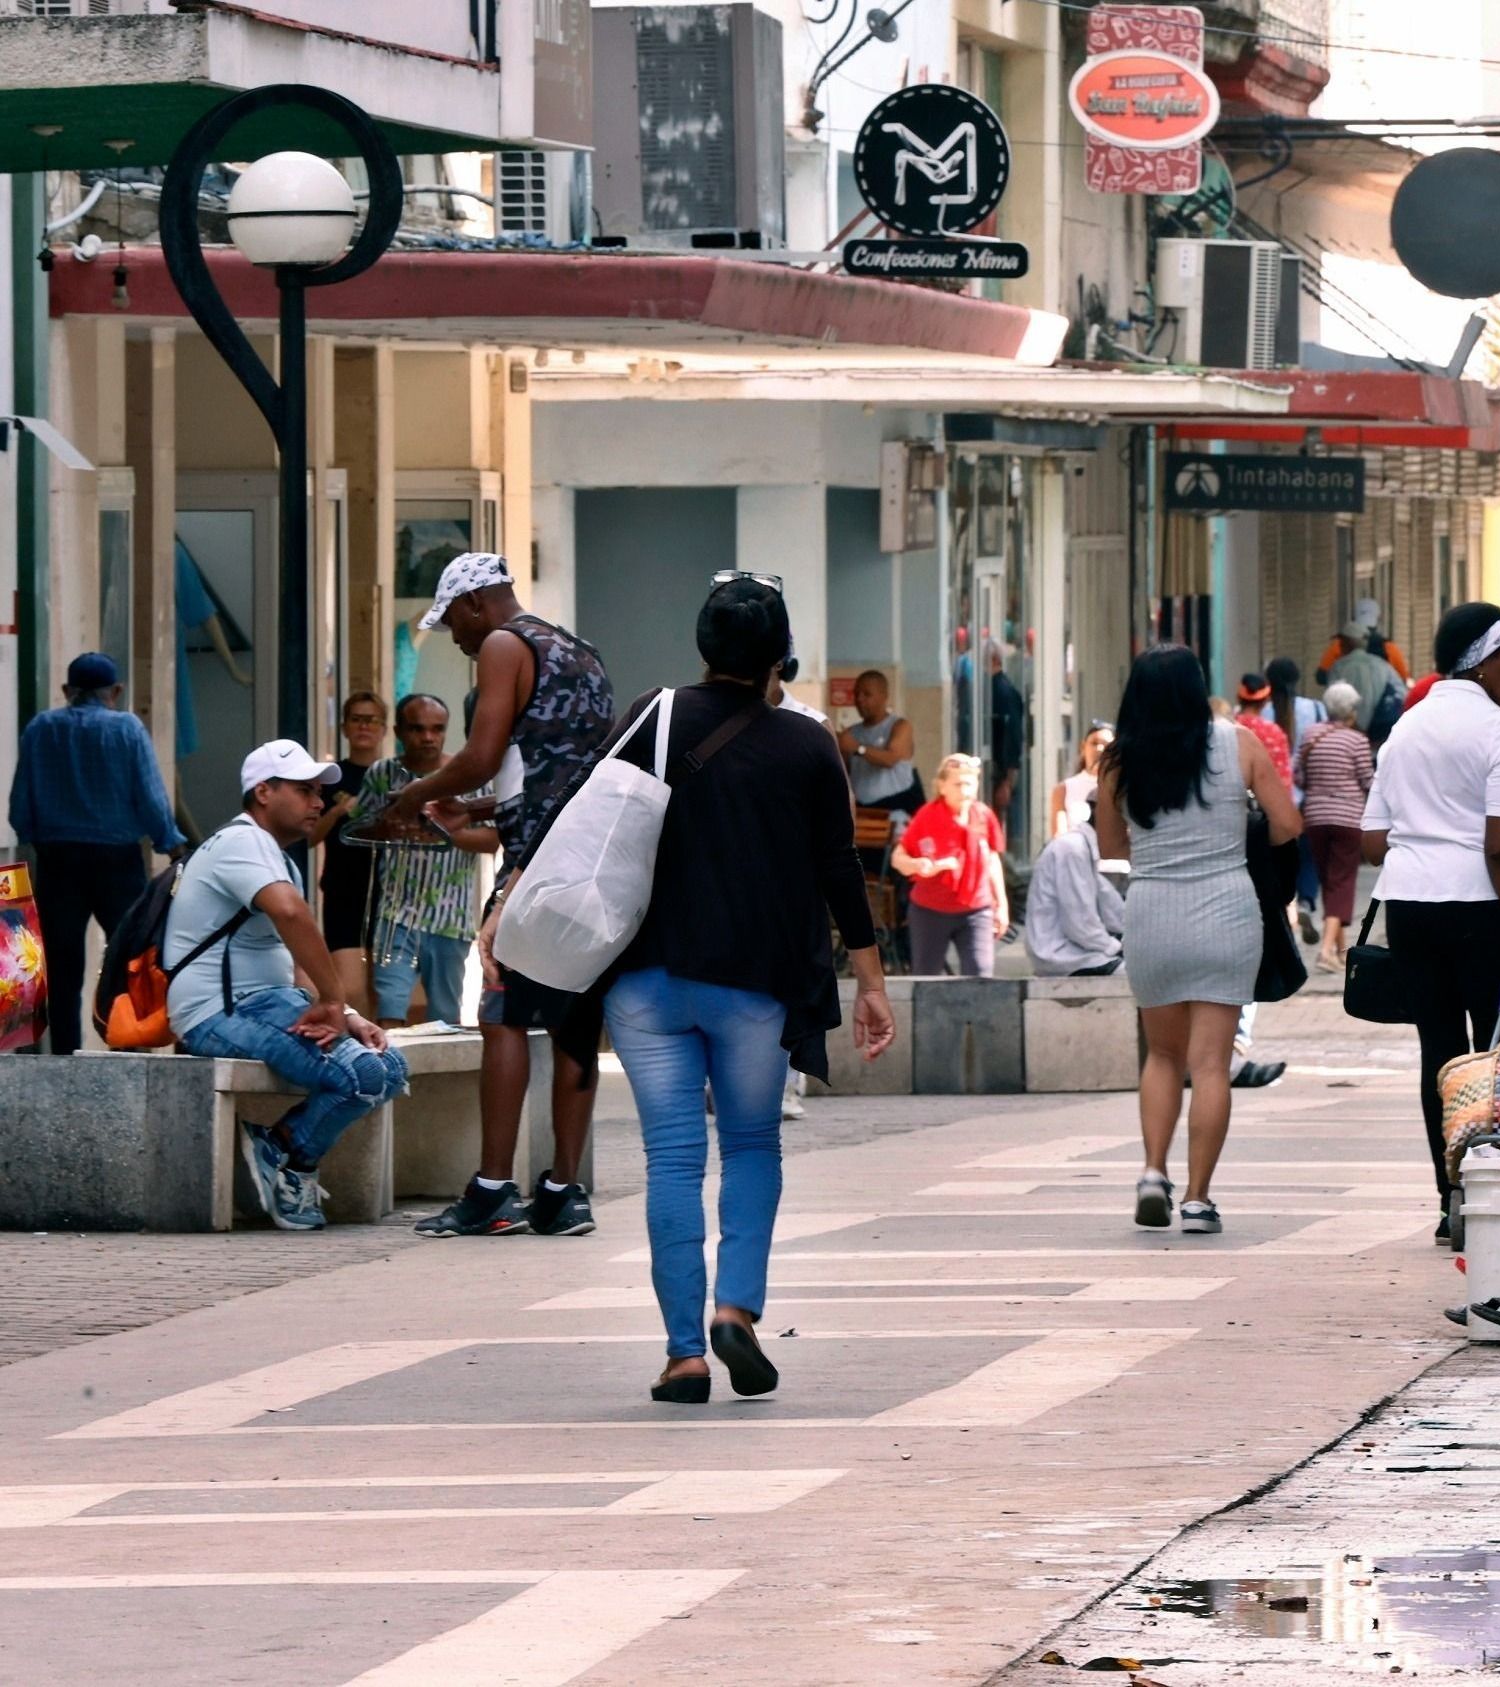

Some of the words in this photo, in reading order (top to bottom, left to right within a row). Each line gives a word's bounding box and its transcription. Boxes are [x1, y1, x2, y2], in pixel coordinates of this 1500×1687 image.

[851, 245, 958, 271] Confecciones
[962, 247, 1020, 270] Mima
[1228, 465, 1355, 488] Tintahabana
